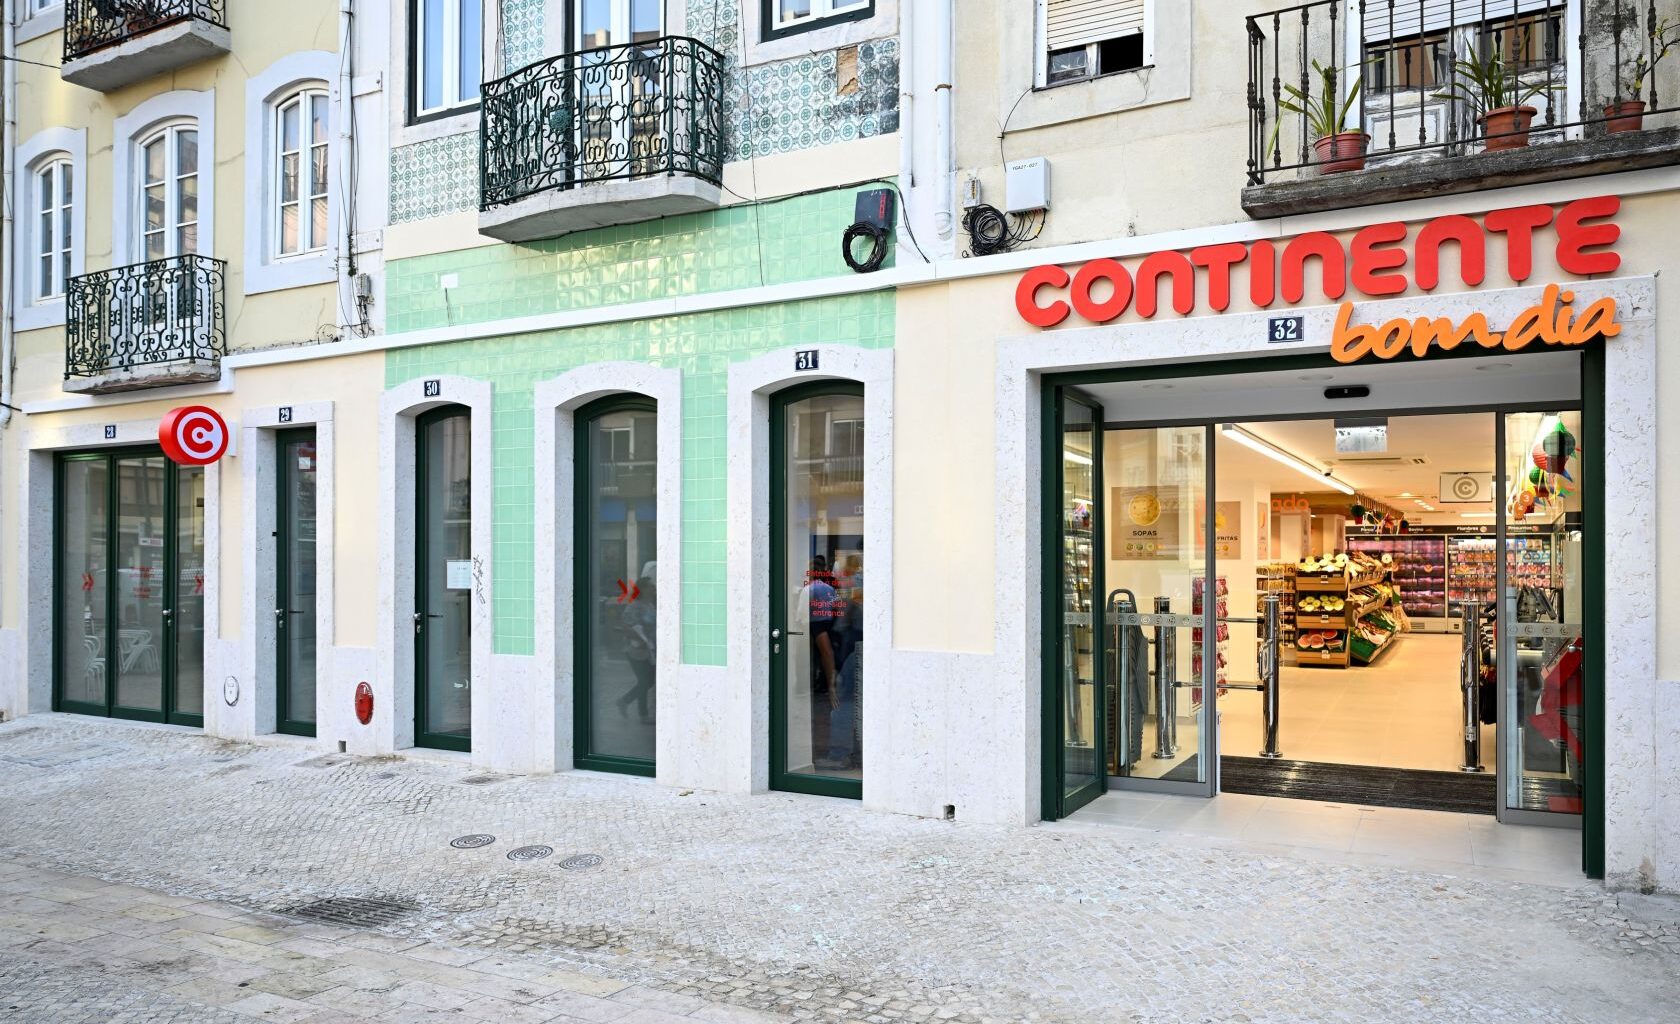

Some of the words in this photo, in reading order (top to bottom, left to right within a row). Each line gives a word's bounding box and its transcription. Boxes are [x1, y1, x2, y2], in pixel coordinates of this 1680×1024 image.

[1015, 195, 1621, 328] CONTINENTE
[1273, 319, 1298, 341] 32
[1330, 301, 1504, 364] bom
[1502, 283, 1622, 351] dia
[798, 351, 815, 369] 31
[426, 381, 438, 396] 30
[280, 408, 290, 422] 29
